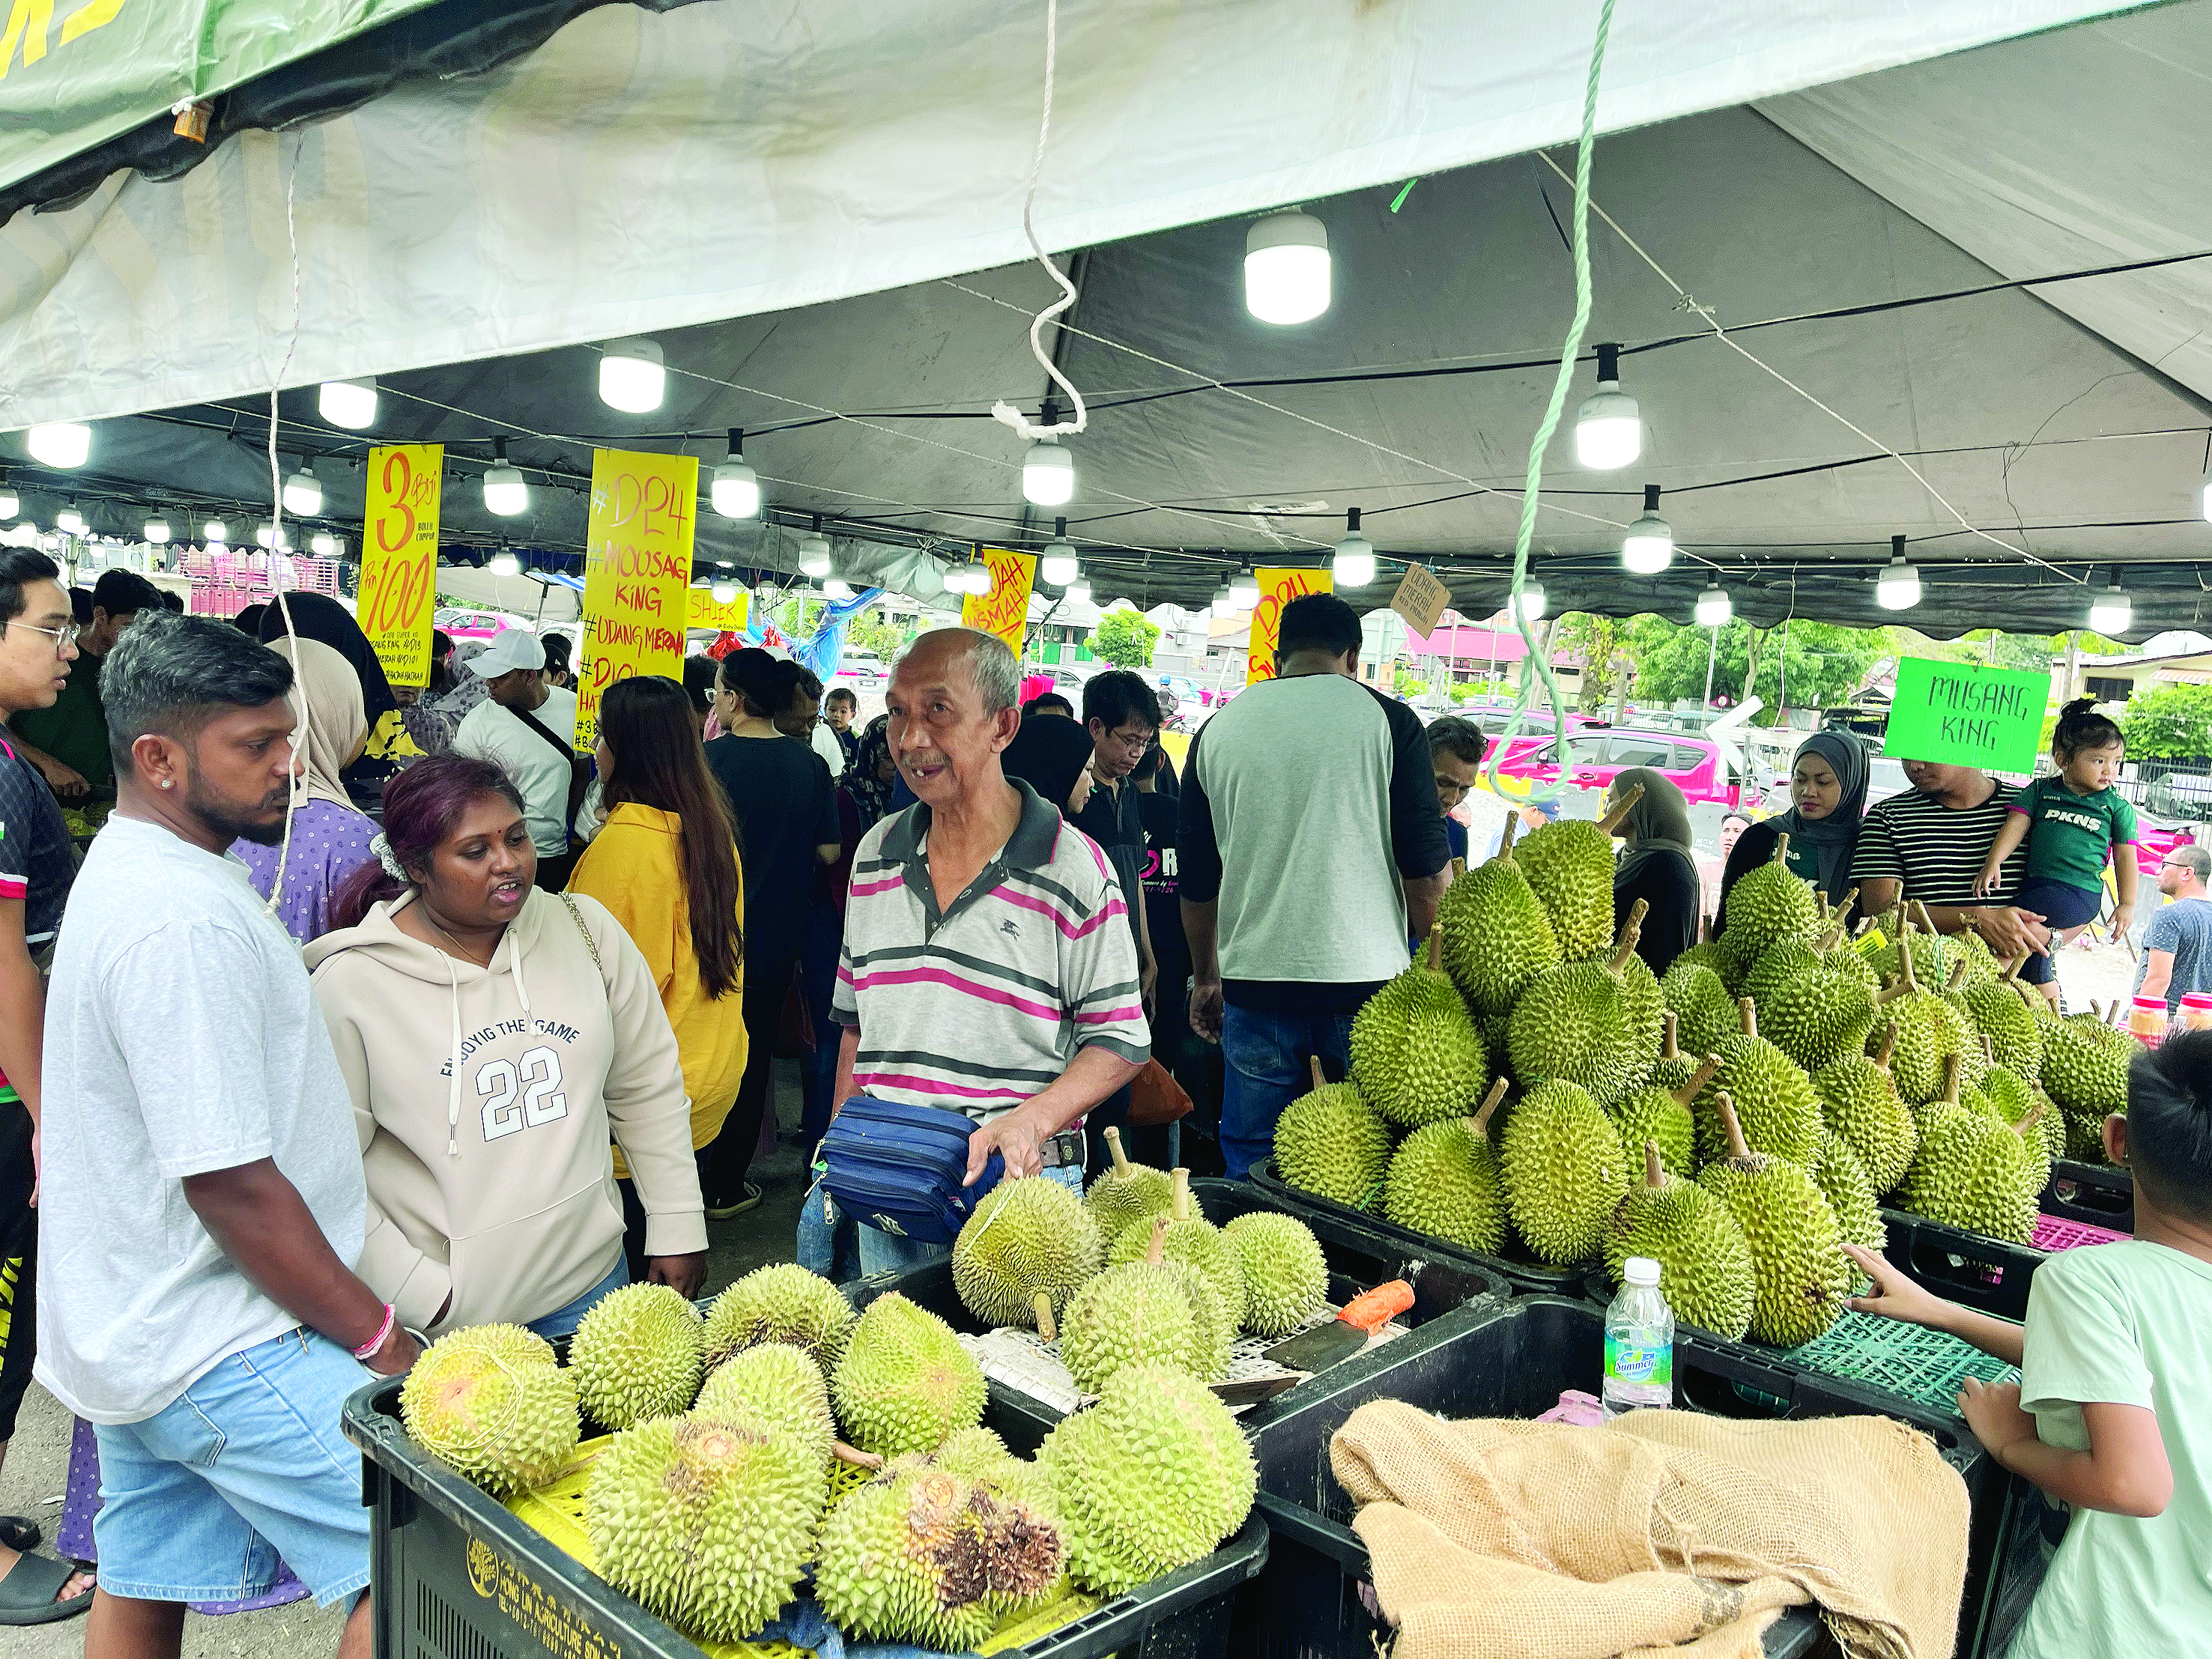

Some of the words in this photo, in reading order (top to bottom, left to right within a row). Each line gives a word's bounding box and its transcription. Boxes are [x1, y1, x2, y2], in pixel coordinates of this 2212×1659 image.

[377, 452, 415, 552] 3
[365, 552, 430, 634] 100
[1403, 584, 1432, 613] MERAH
[1411, 569, 1440, 601] UDANG
[584, 613, 643, 658] #UDANG
[1928, 676, 2031, 721] MUSANG
[1941, 716, 1999, 750] KING
[2045, 809, 2102, 831] PKNS
[495, 1019, 526, 1036] THE
[535, 1019, 581, 1045] GAME
[476, 1046, 568, 1142] 22
[1615, 1359, 1653, 1373] Summer
[534, 1600, 582, 1656] AGRICULTURE
